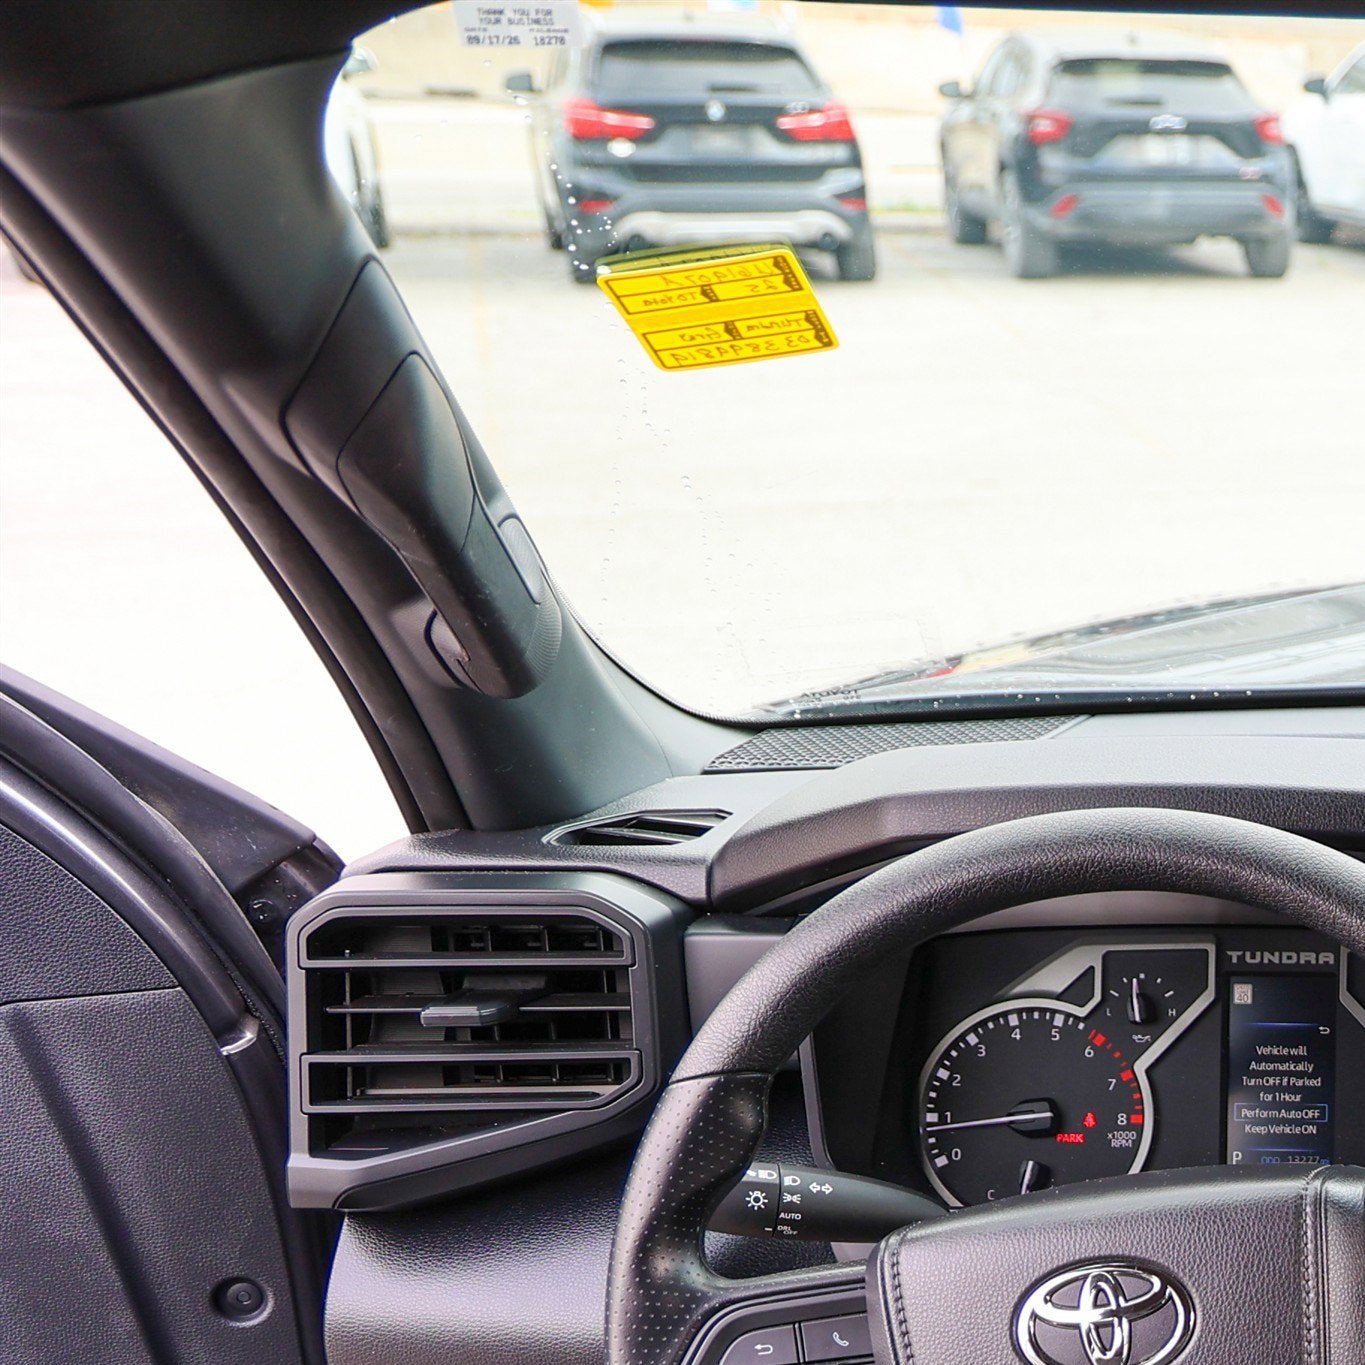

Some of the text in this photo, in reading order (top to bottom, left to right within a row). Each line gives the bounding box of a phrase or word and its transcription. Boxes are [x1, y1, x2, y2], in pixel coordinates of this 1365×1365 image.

[512, 8, 530, 16] YOU
[535, 8, 553, 16] FOR
[507, 18, 554, 26] BUSINESS
[1226, 950, 1335, 965] TUNDRA
[1010, 1028, 1022, 1040] 4
[1050, 1028, 1060, 1041] 5
[977, 1045, 986, 1057] 3
[1084, 1046, 1094, 1058] 6
[1256, 1045, 1308, 1056] Vehicle will
[1249, 1060, 1314, 1072] Automatically
[952, 1074, 962, 1086] 2
[1107, 1078, 1117, 1091] 7
[1242, 1076, 1322, 1087] Turn OFF if Parked
[1260, 1092, 1273, 1102] for
[1280, 1092, 1302, 1102] Hour
[1117, 1112, 1128, 1125] 8
[1241, 1108, 1320, 1119] Perform Auto OFF
[1244, 1124, 1317, 1136] Keep Vehicle ON
[1056, 1134, 1085, 1144] PARK
[1111, 1139, 1132, 1148] RPM
[952, 1148, 962, 1160] 0
[1232, 1151, 1242, 1164] P
[779, 1212, 802, 1220] AUTO
